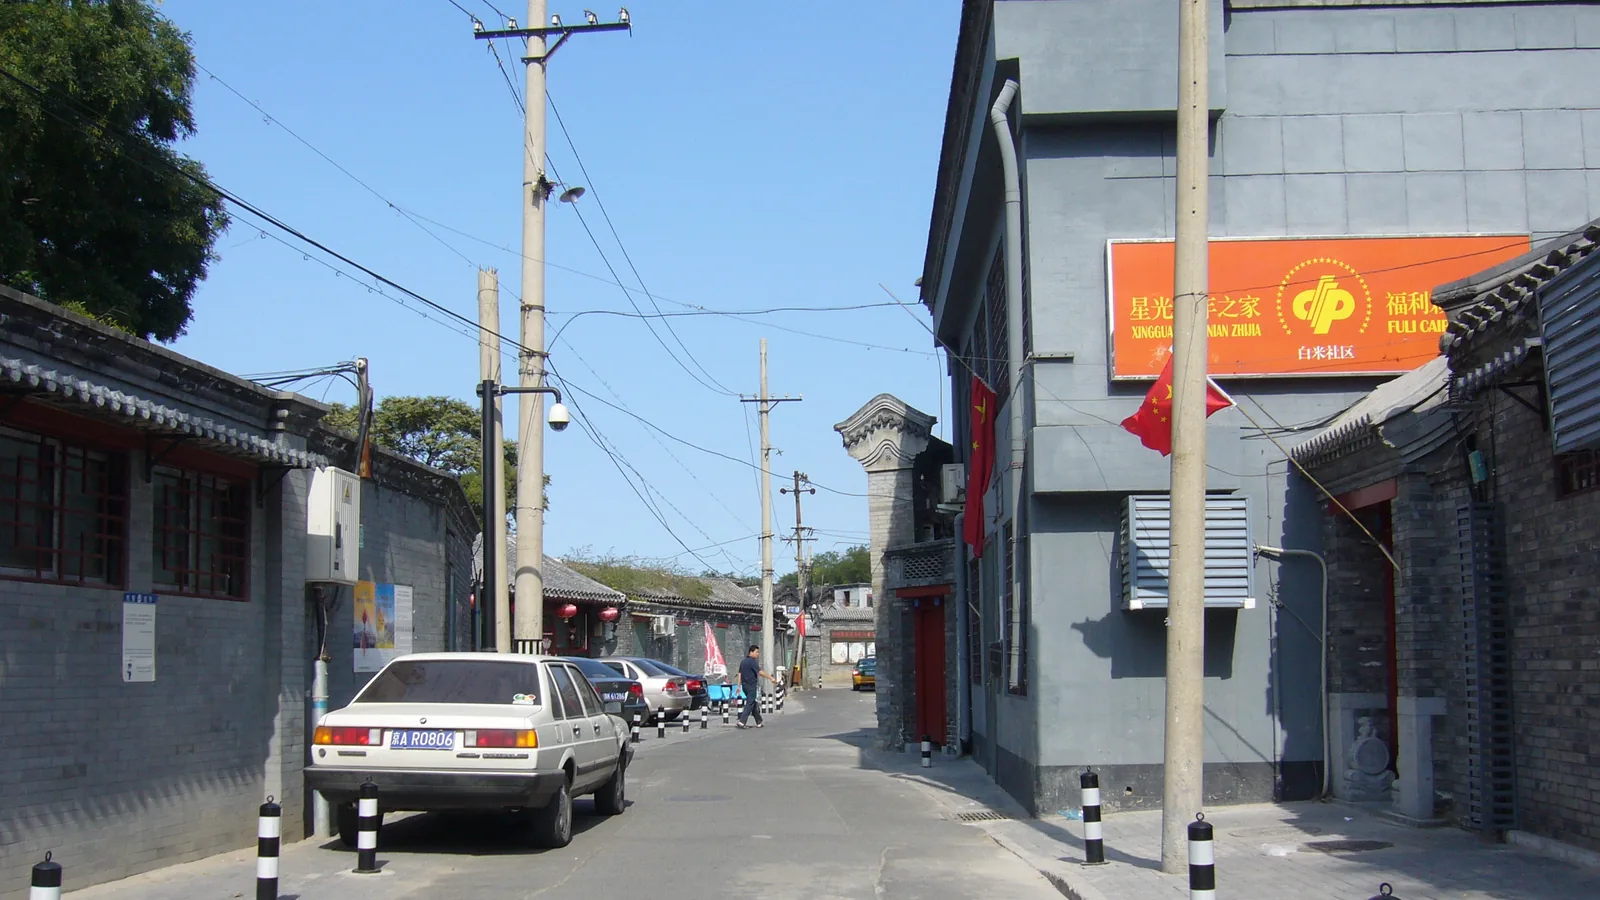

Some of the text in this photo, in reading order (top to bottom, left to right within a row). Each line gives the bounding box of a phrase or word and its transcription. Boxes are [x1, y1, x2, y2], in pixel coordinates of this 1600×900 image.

[1130, 295, 1261, 321] 星光年之家
[1132, 325, 1173, 339] XINGGUA
[1231, 323, 1261, 337] ZHIJIA
[1387, 319, 1449, 333] FULI CAIP
[1298, 345, 1355, 360] 白米社区
[411, 730, 454, 746] R0806
